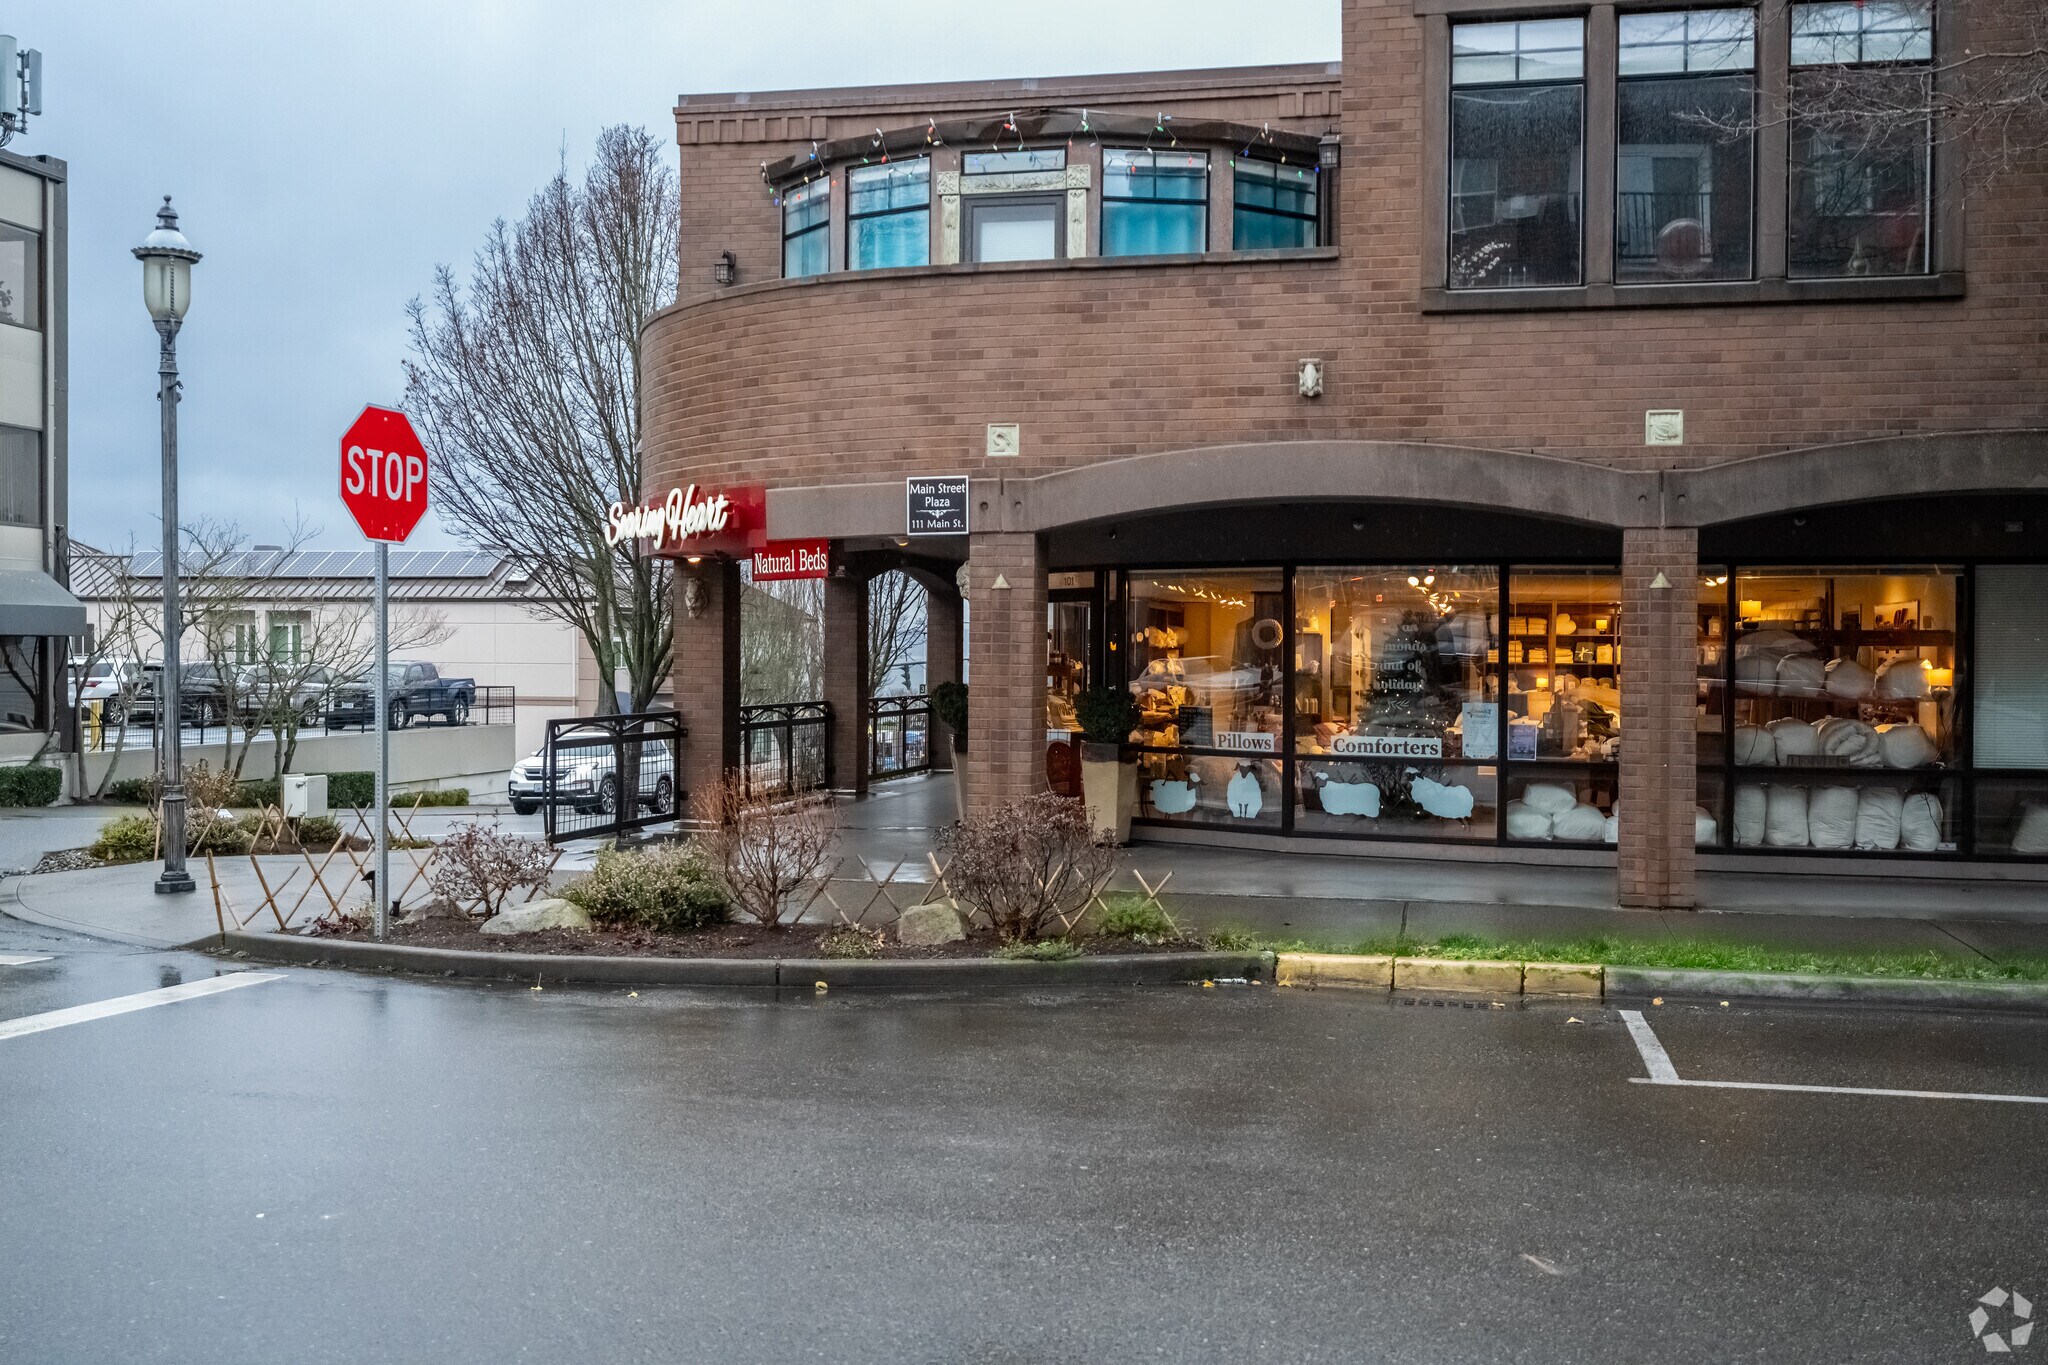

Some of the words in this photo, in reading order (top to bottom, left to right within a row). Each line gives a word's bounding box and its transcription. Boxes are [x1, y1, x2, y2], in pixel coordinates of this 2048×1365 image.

[345, 445, 424, 502] STOP
[909, 483, 935, 495] Main
[938, 482, 966, 494] Street
[925, 496, 950, 507] Plaza
[665, 483, 729, 541] Heart
[911, 519, 924, 529] 111
[927, 519, 950, 528] Main
[953, 518, 964, 528] St.
[754, 549, 795, 574] Natural
[799, 546, 827, 571] Beds
[1063, 576, 1075, 586] 101
[1407, 659, 1422, 674] of
[1217, 733, 1272, 750] Pillows
[1333, 738, 1439, 756] Comforters
